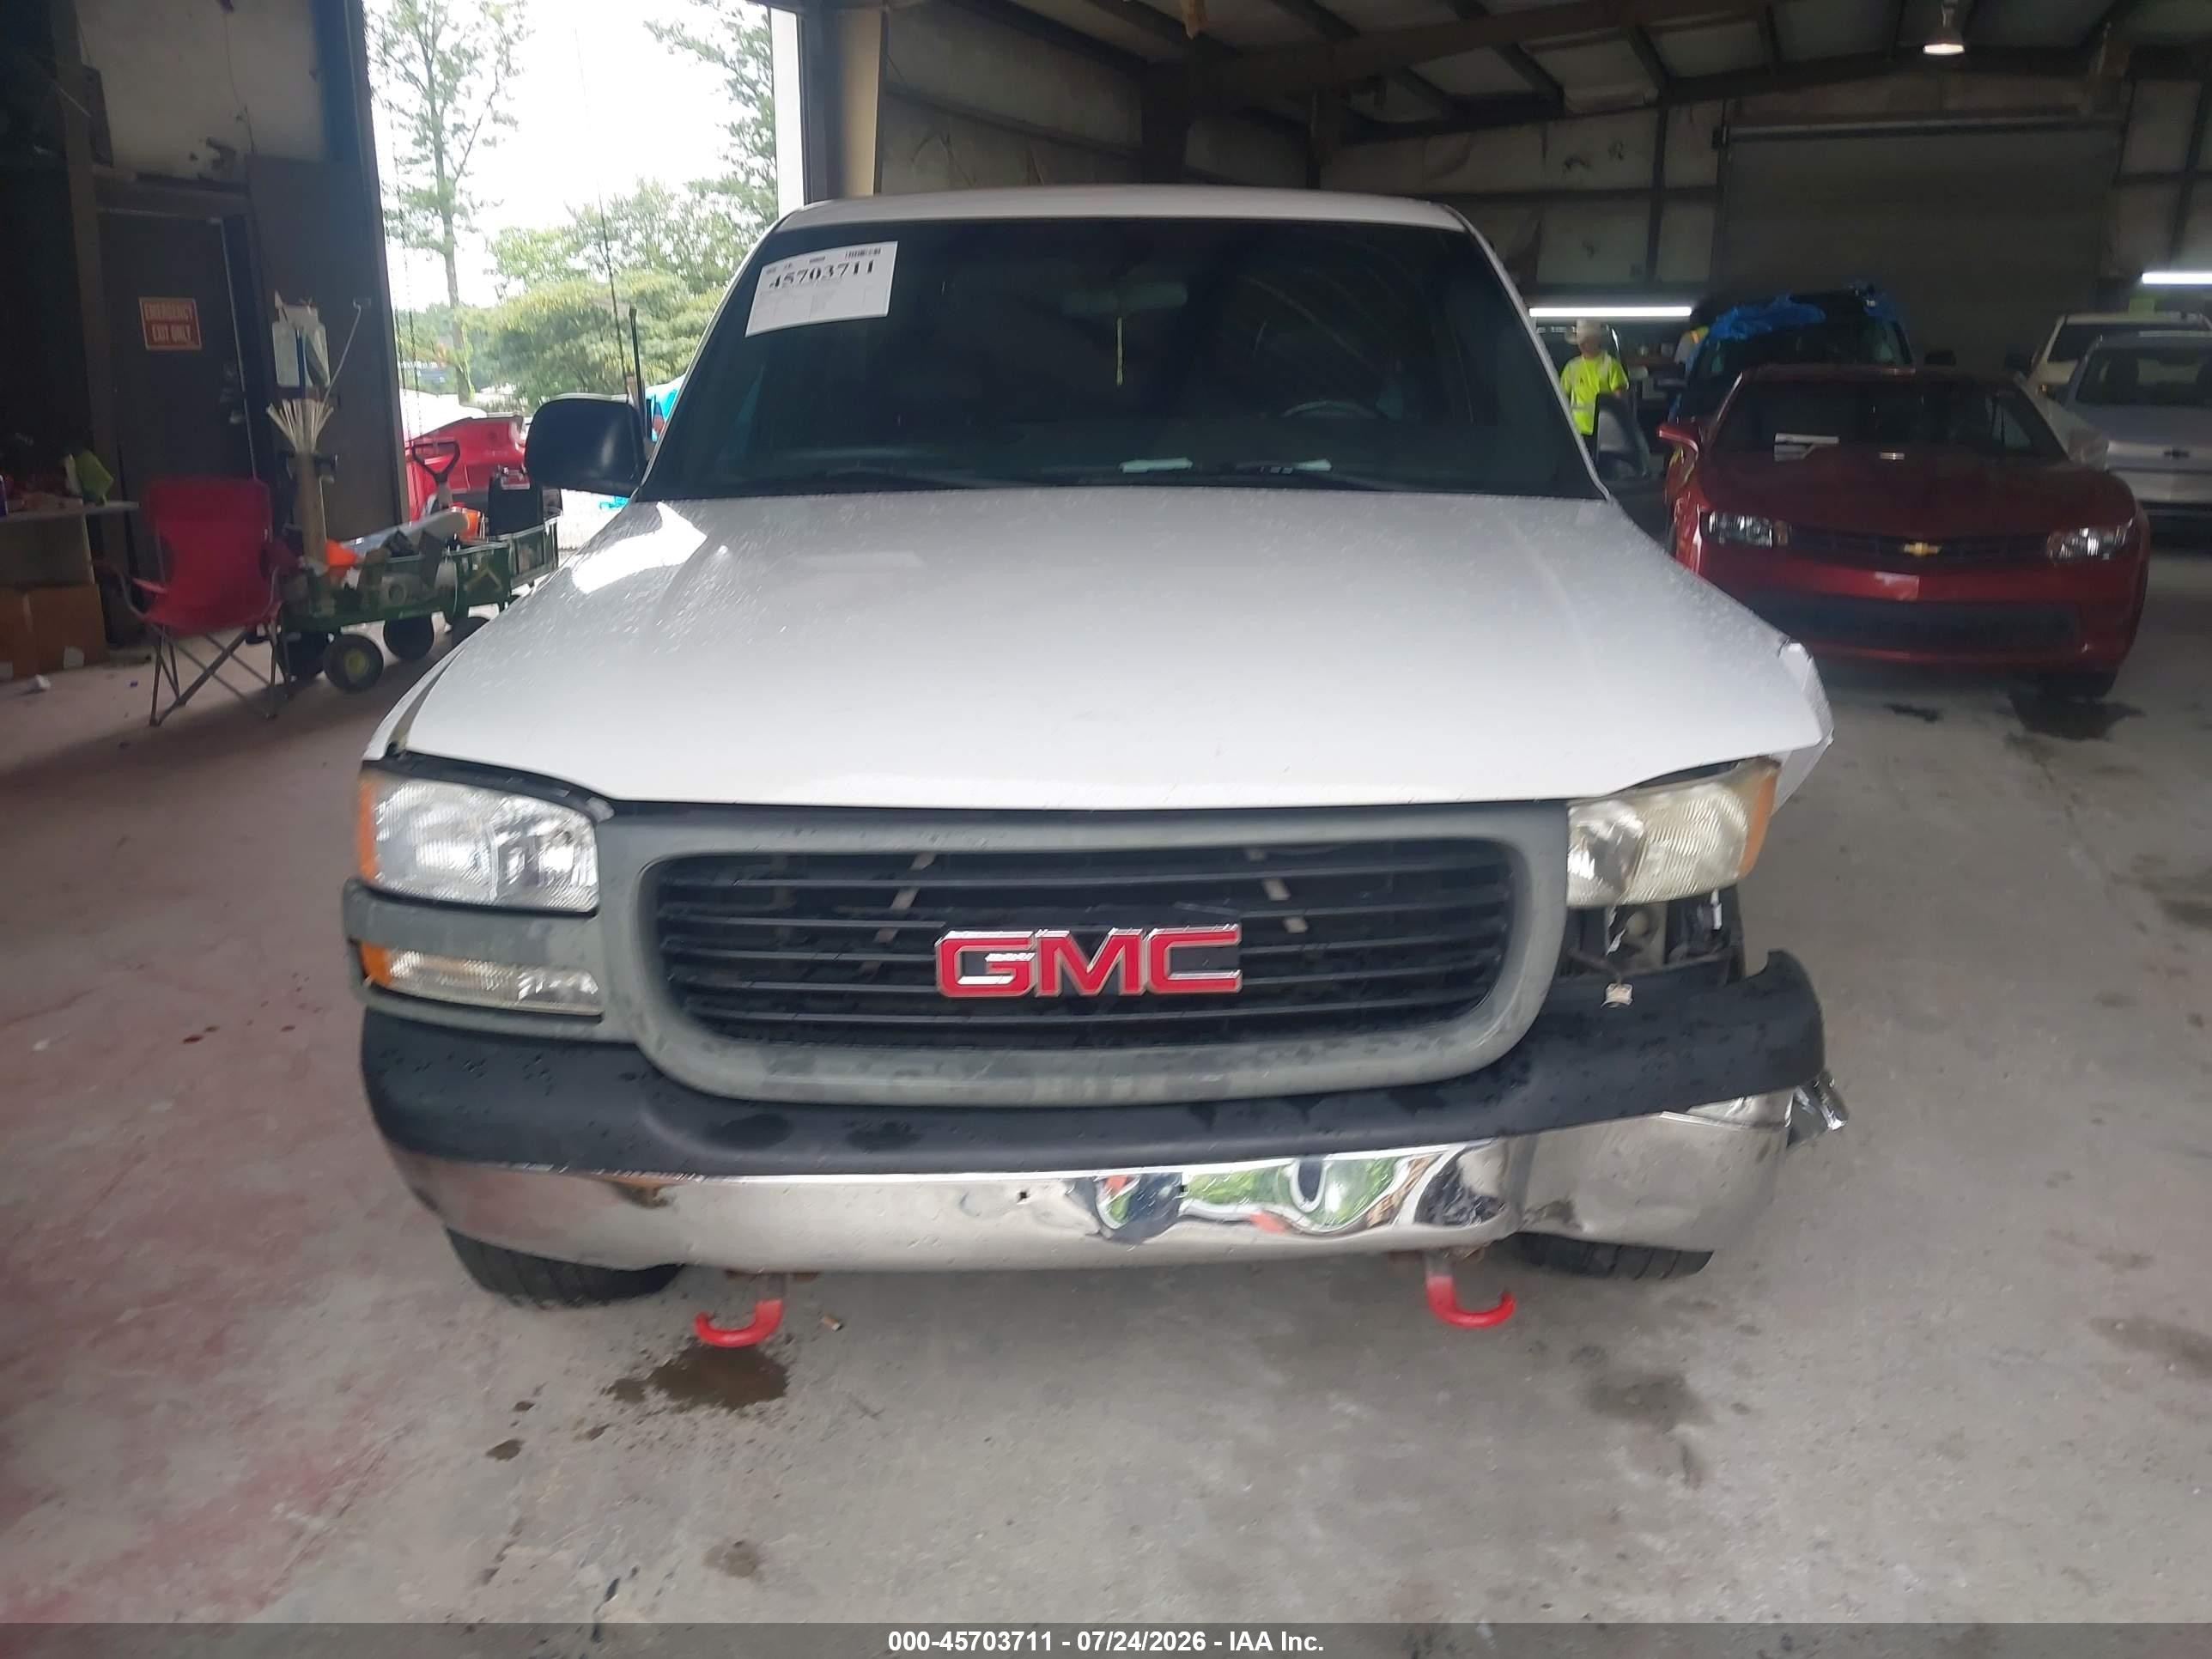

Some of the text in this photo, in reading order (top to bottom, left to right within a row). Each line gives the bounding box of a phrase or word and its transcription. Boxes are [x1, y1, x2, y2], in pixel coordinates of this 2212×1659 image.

[769, 259, 874, 289] 45703711
[151, 324, 170, 343] EXIT
[934, 924, 1243, 998] GMC
